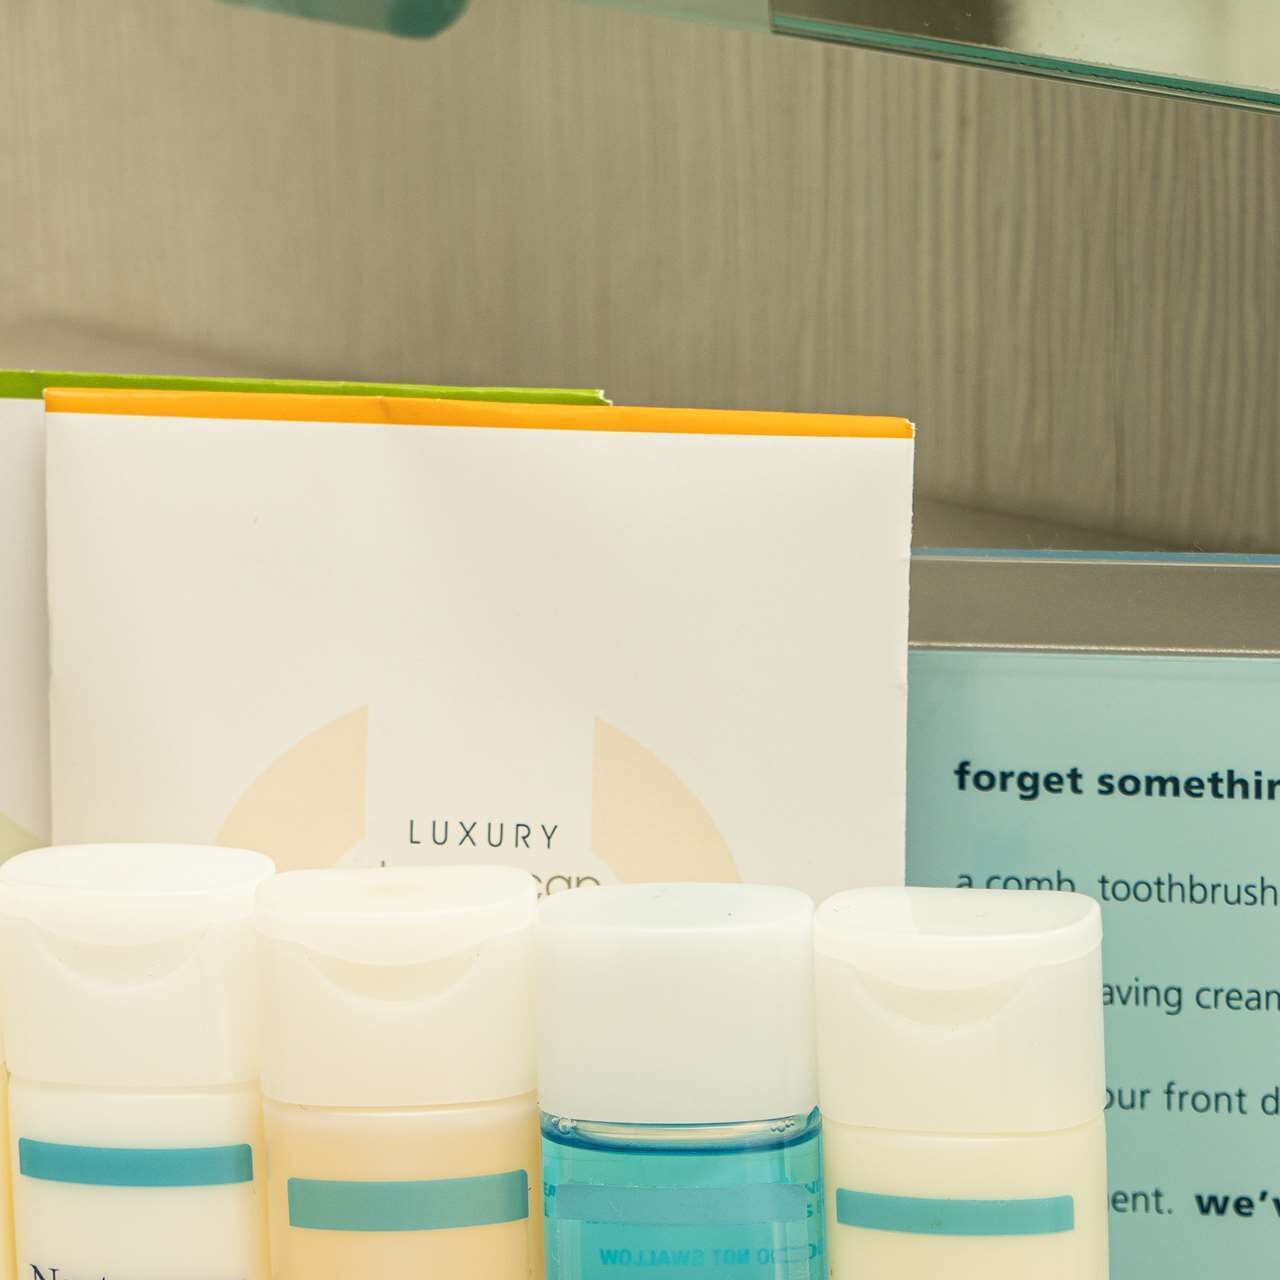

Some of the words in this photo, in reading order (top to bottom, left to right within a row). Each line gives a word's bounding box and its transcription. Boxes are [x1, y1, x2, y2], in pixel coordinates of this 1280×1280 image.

[954, 761, 1083, 800] forget
[409, 819, 558, 849] LUXURY
[1102, 977, 1182, 1015] aving
[1164, 1081, 1247, 1114] front
[1106, 1187, 1173, 1214] ent.
